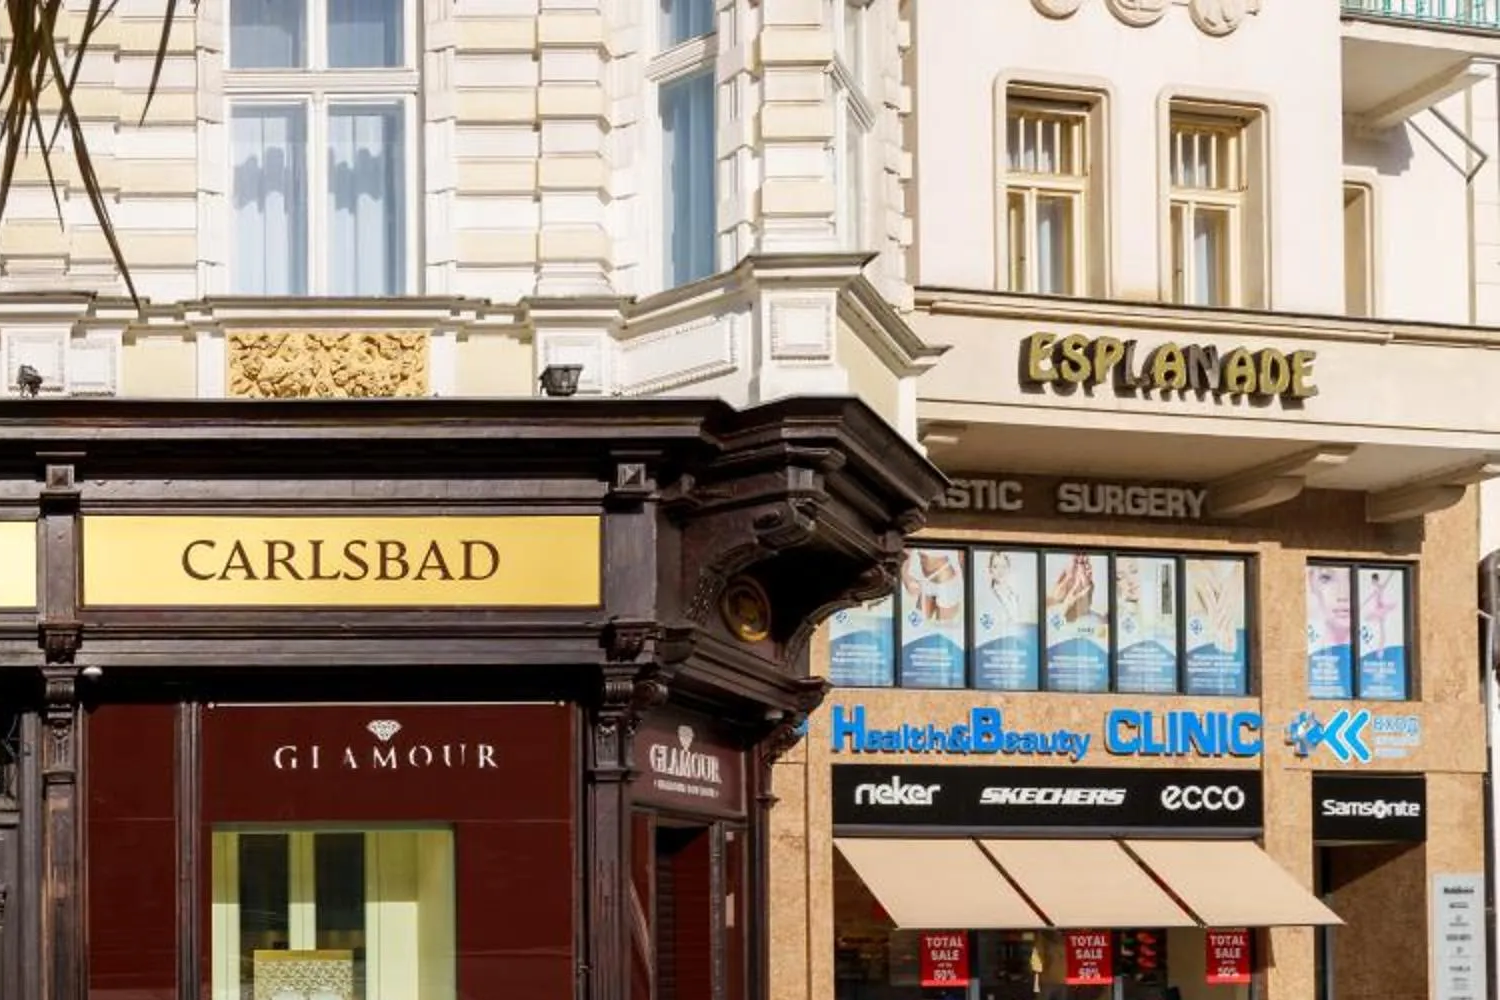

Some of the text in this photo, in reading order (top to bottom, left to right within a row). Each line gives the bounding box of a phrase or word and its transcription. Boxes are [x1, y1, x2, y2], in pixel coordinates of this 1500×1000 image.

[1019, 331, 1318, 398] ESPLANADE
[1057, 482, 1207, 518] SURGERY
[181, 539, 501, 581] CARLSBAD
[1104, 708, 1264, 759] CLINIC
[273, 743, 498, 769] GLAMOUR
[649, 743, 723, 785] GLAMOUR
[854, 775, 1246, 811] rieker SKECHERS ecco
[1321, 799, 1421, 819] Samsonite
[925, 936, 964, 949] TOTAL
[1069, 935, 1108, 948] TOTAL
[1209, 935, 1245, 947] TOTAL
[931, 949, 960, 962] SALE
[1075, 948, 1103, 960] SALE
[1215, 947, 1241, 959] SALE
